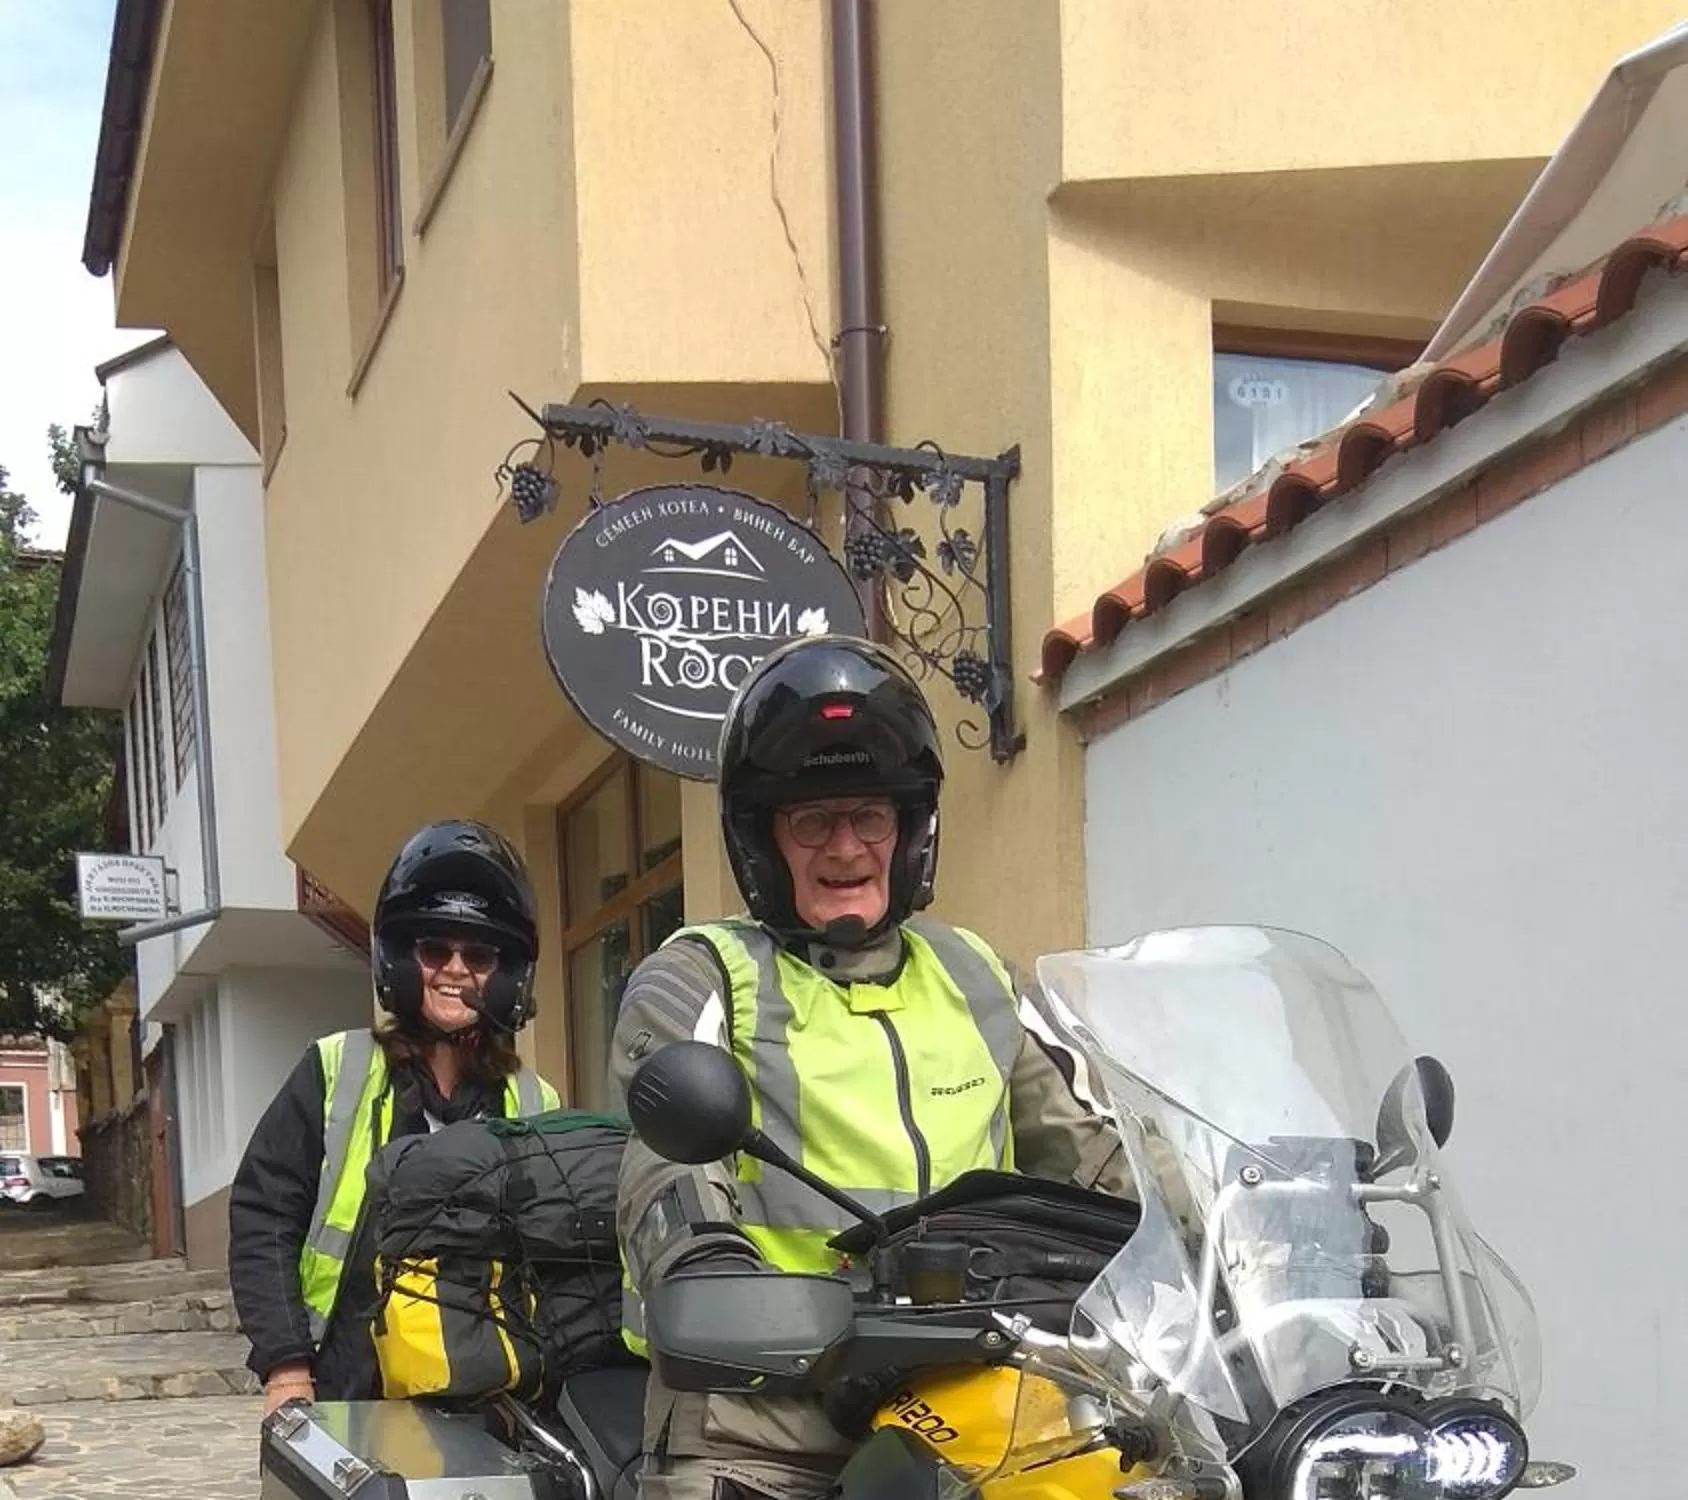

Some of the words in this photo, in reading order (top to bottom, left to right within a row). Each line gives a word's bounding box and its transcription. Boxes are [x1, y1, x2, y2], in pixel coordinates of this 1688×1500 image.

[595, 505, 653, 548] СЕМЕЕН
[658, 499, 709, 517] ХОТЕЛ
[733, 507, 785, 541] ВИНЕН
[787, 537, 815, 565] БАР
[639, 636, 763, 691] ROO
[612, 707, 666, 750] FAMILY
[671, 741, 716, 762] HOTE
